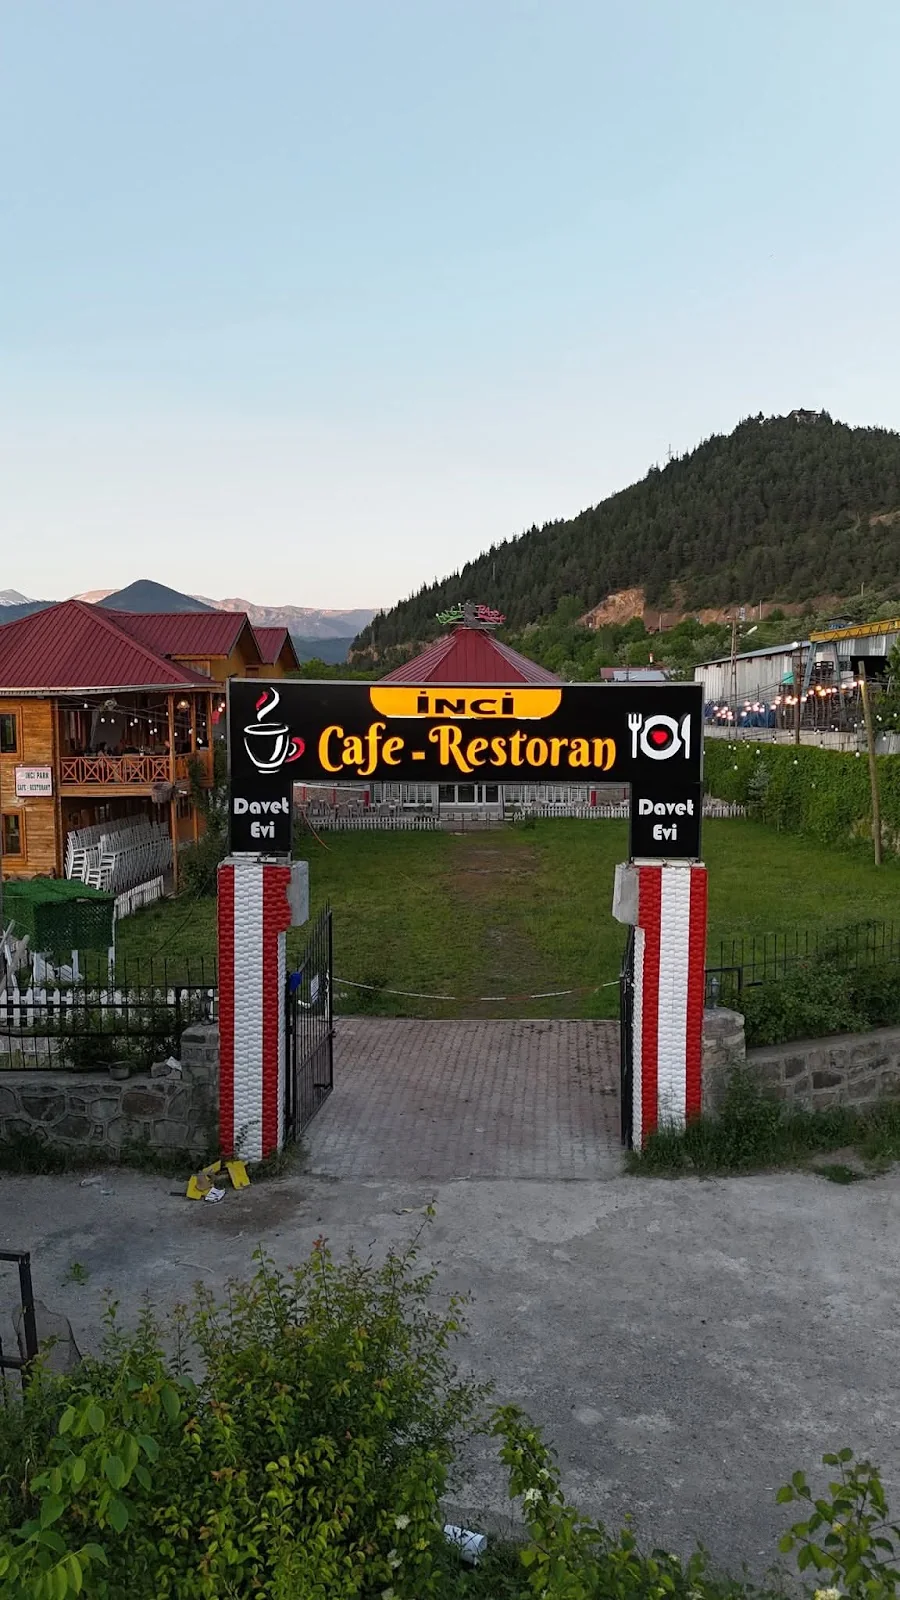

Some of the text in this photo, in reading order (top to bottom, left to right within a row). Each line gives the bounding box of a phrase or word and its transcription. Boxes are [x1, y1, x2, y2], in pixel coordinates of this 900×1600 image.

[417, 690, 514, 715] İNCİ
[318, 722, 405, 776] Cafe
[428, 724, 617, 774] Restoran
[233, 796, 290, 816] Davet
[638, 797, 695, 817] Davet
[250, 820, 275, 839] Evi
[653, 823, 677, 841] Evi
